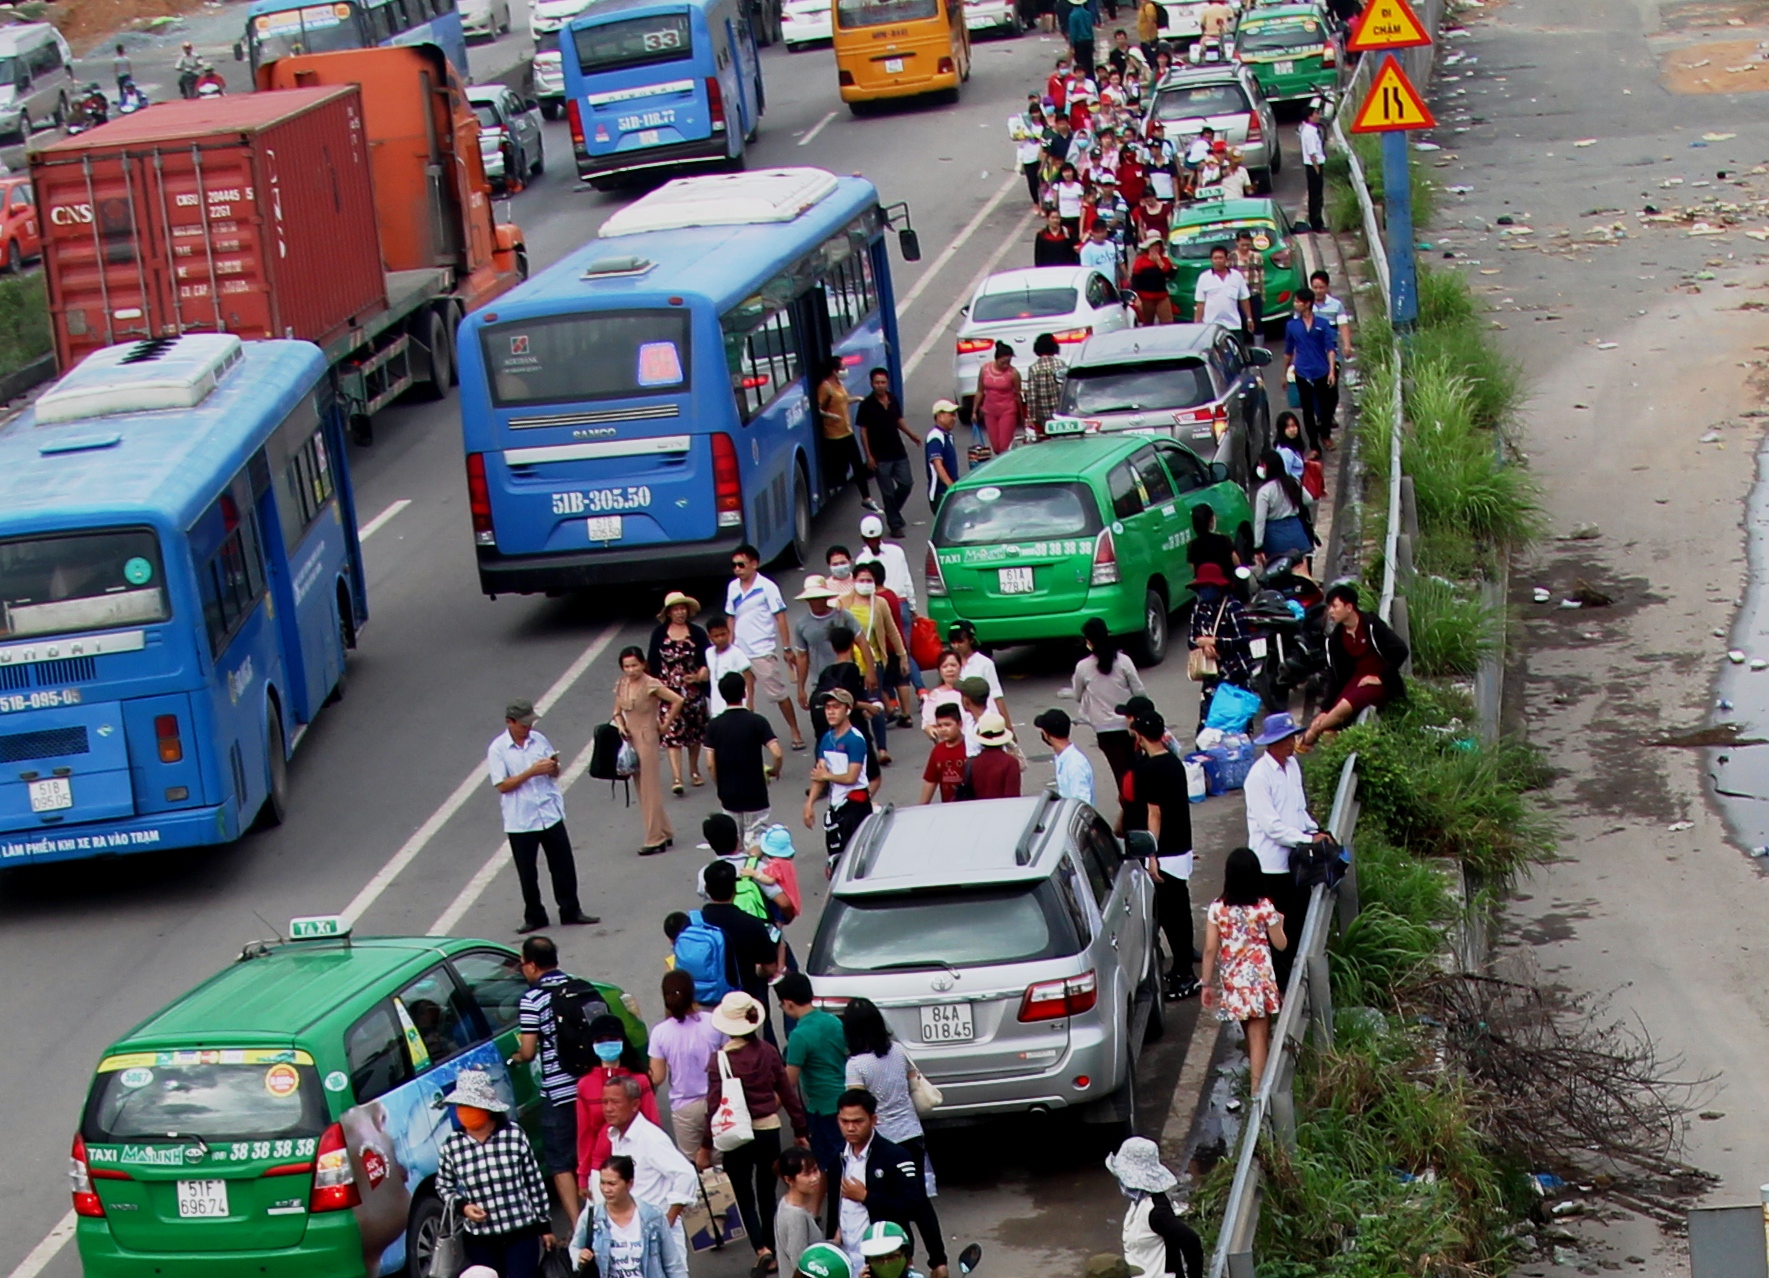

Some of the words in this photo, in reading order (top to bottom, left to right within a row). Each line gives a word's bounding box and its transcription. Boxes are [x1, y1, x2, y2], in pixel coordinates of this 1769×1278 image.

[646, 32, 678, 50] 33
[245, 187, 254, 200] 5
[51, 204, 93, 225] CNS
[572, 427, 616, 439] SAMCO
[552, 485, 651, 514] 51B-305.50
[938, 554, 961, 564] TAXI
[1006, 568, 1024, 581] 61A
[39, 781, 60, 796] 51B
[59, 839, 75, 851] KHI
[77, 836, 91, 849] XE
[108, 831, 128, 846] VÀO
[933, 1005, 959, 1022] 84A
[88, 1148, 117, 1162] TAXI
[230, 1143, 248, 1161] 38
[251, 1142, 270, 1159] 38
[274, 1140, 292, 1158] 38
[295, 1138, 315, 1156] 38
[189, 1180, 214, 1196] 51F
[807, 1260, 829, 1277] Grab
